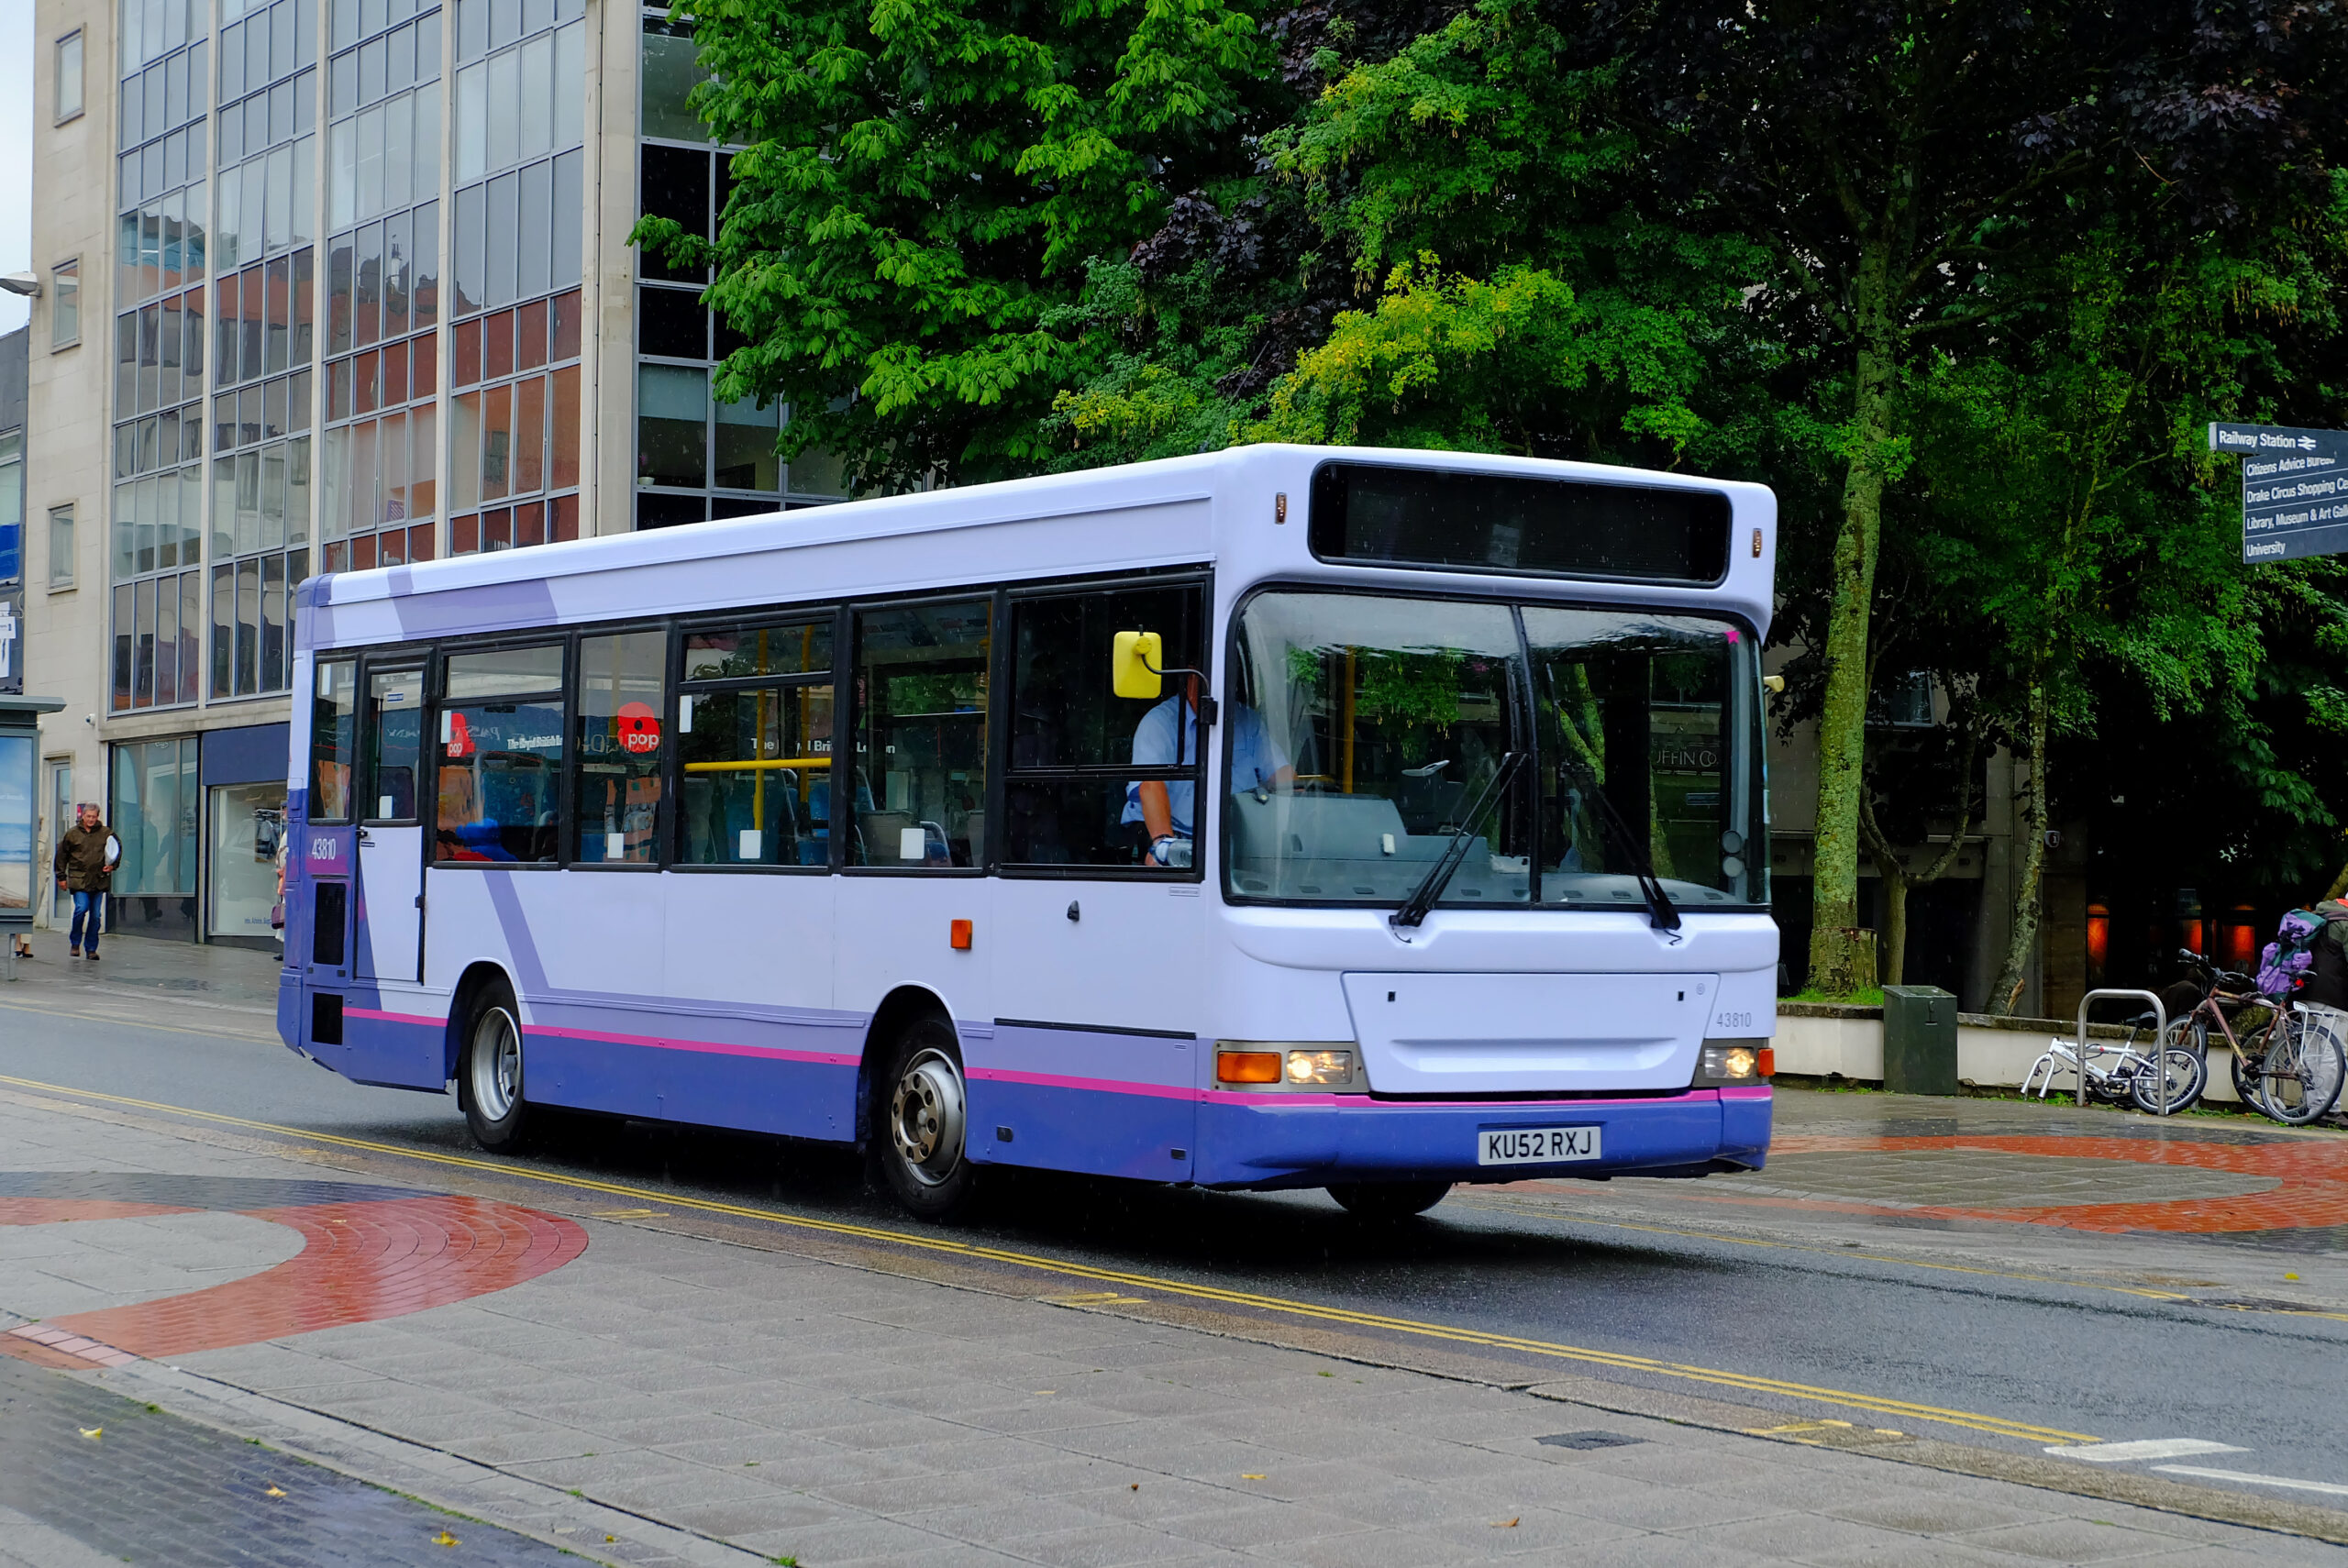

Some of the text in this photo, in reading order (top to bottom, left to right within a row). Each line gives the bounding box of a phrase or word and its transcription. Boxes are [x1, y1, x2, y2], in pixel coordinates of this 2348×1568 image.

[2219, 430, 2296, 448] Railway Station
[2246, 462, 2277, 477] Citizens
[2278, 458, 2306, 472] Advice
[2246, 489, 2270, 503] Drake
[2271, 486, 2297, 500] Circus
[2297, 480, 2335, 496] Shopping
[2246, 516, 2275, 530] Library,
[2276, 513, 2309, 525] Museum
[2309, 508, 2317, 521] &
[2319, 507, 2331, 520] Art
[2246, 540, 2286, 557] University
[627, 734, 659, 749] pop
[312, 838, 337, 860] 43810
[1717, 1012, 1752, 1028] 43810
[1489, 1131, 1591, 1159] KU52 RXJ
